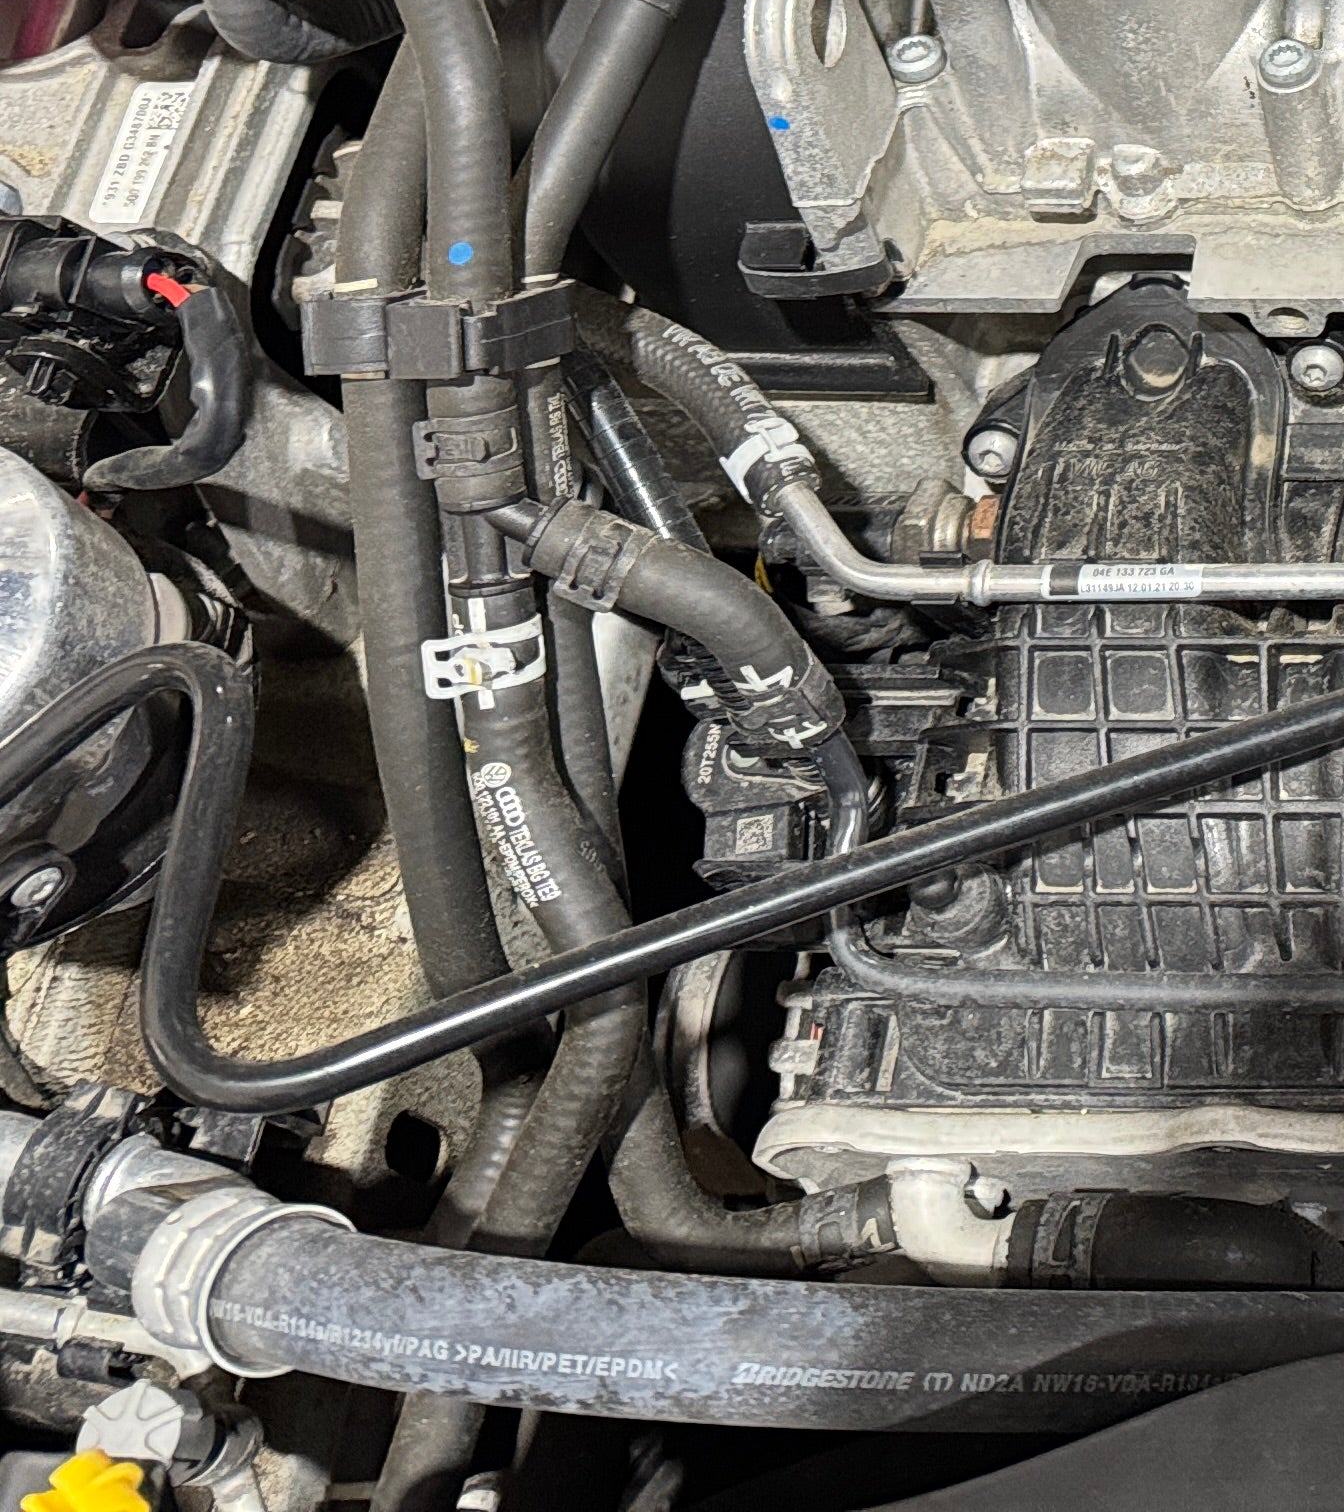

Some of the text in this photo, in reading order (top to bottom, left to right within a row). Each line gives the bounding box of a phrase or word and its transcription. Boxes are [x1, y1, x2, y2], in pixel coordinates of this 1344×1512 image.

[1092, 565, 1175, 577] 04E 133 723 GA
[507, 823, 544, 868] TEKLAS
[731, 1361, 915, 1391] BRIDGESTONE
[960, 1371, 1023, 1394] ND2A
